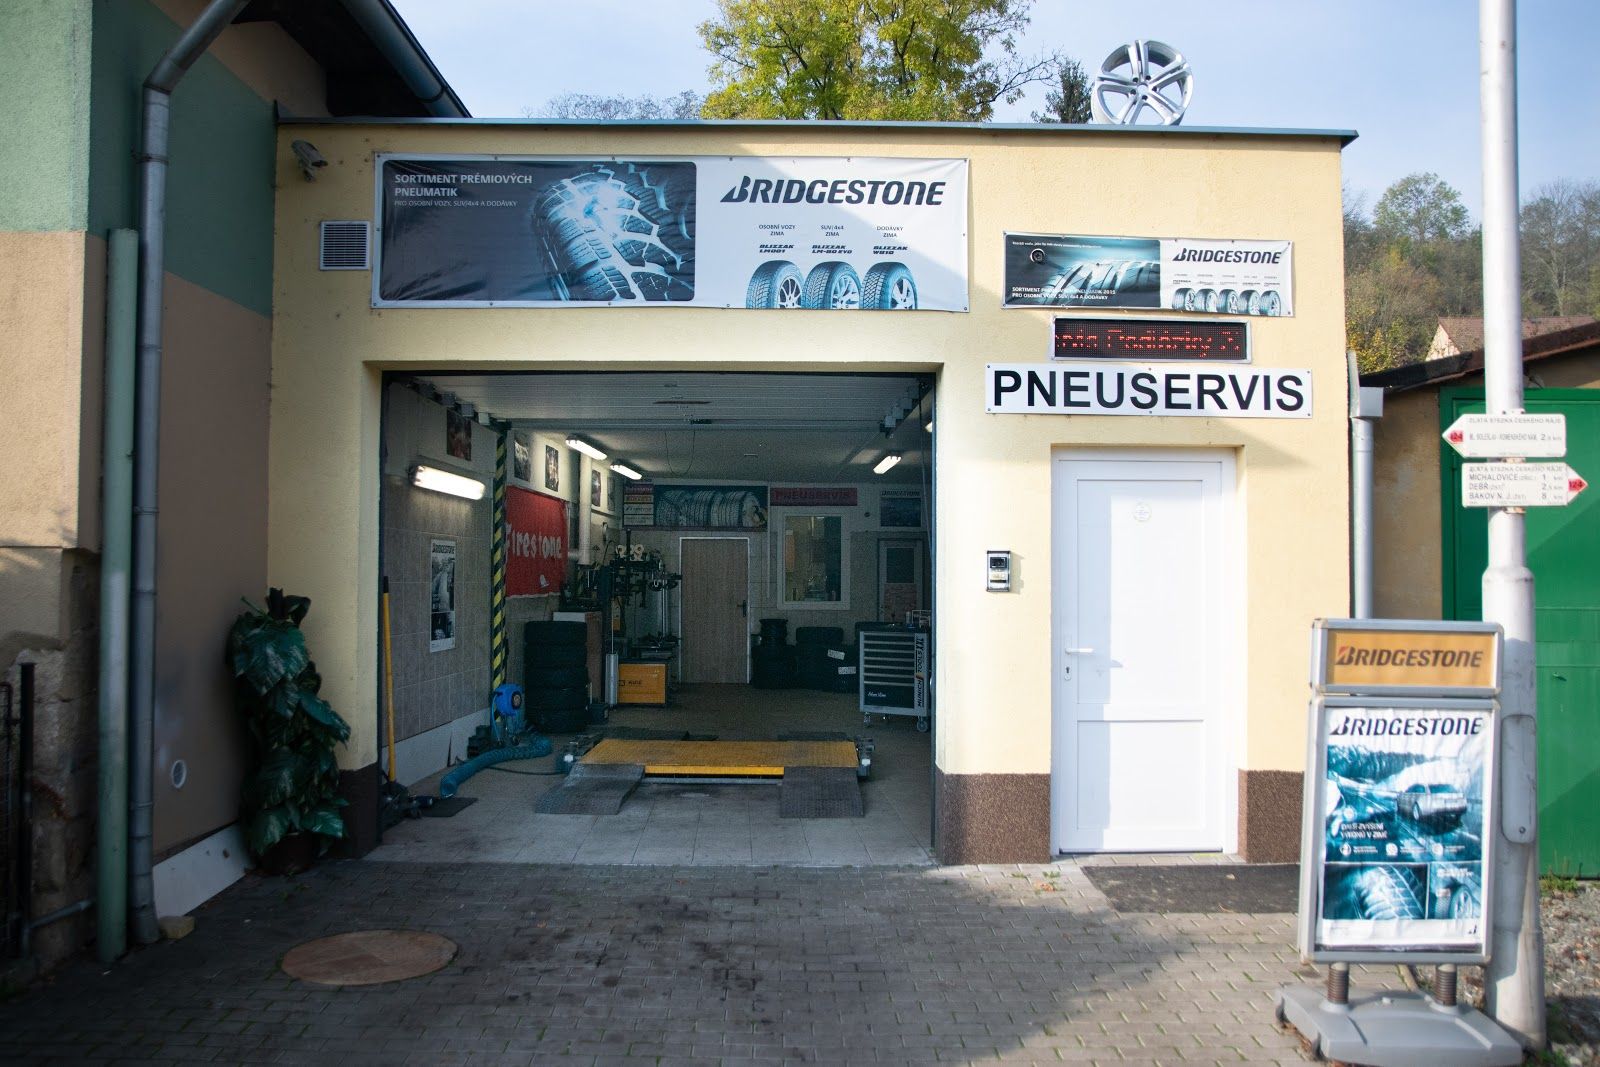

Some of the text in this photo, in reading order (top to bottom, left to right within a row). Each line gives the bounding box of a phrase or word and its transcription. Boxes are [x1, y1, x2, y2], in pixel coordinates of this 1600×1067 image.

[394, 172, 533, 185] SORTIMENT PRÉMIOVÝCH
[394, 187, 458, 197] PNEUMATIK
[720, 175, 946, 206] BRIDGESTONE
[1172, 247, 1282, 265] BRIDGESTONE
[993, 369, 1305, 412] PNEUSERVIS
[1469, 473, 1518, 481] MICHALOVICE
[1335, 645, 1484, 668] BRIDGESTONE
[1330, 716, 1484, 736] BRIDGESTONE
